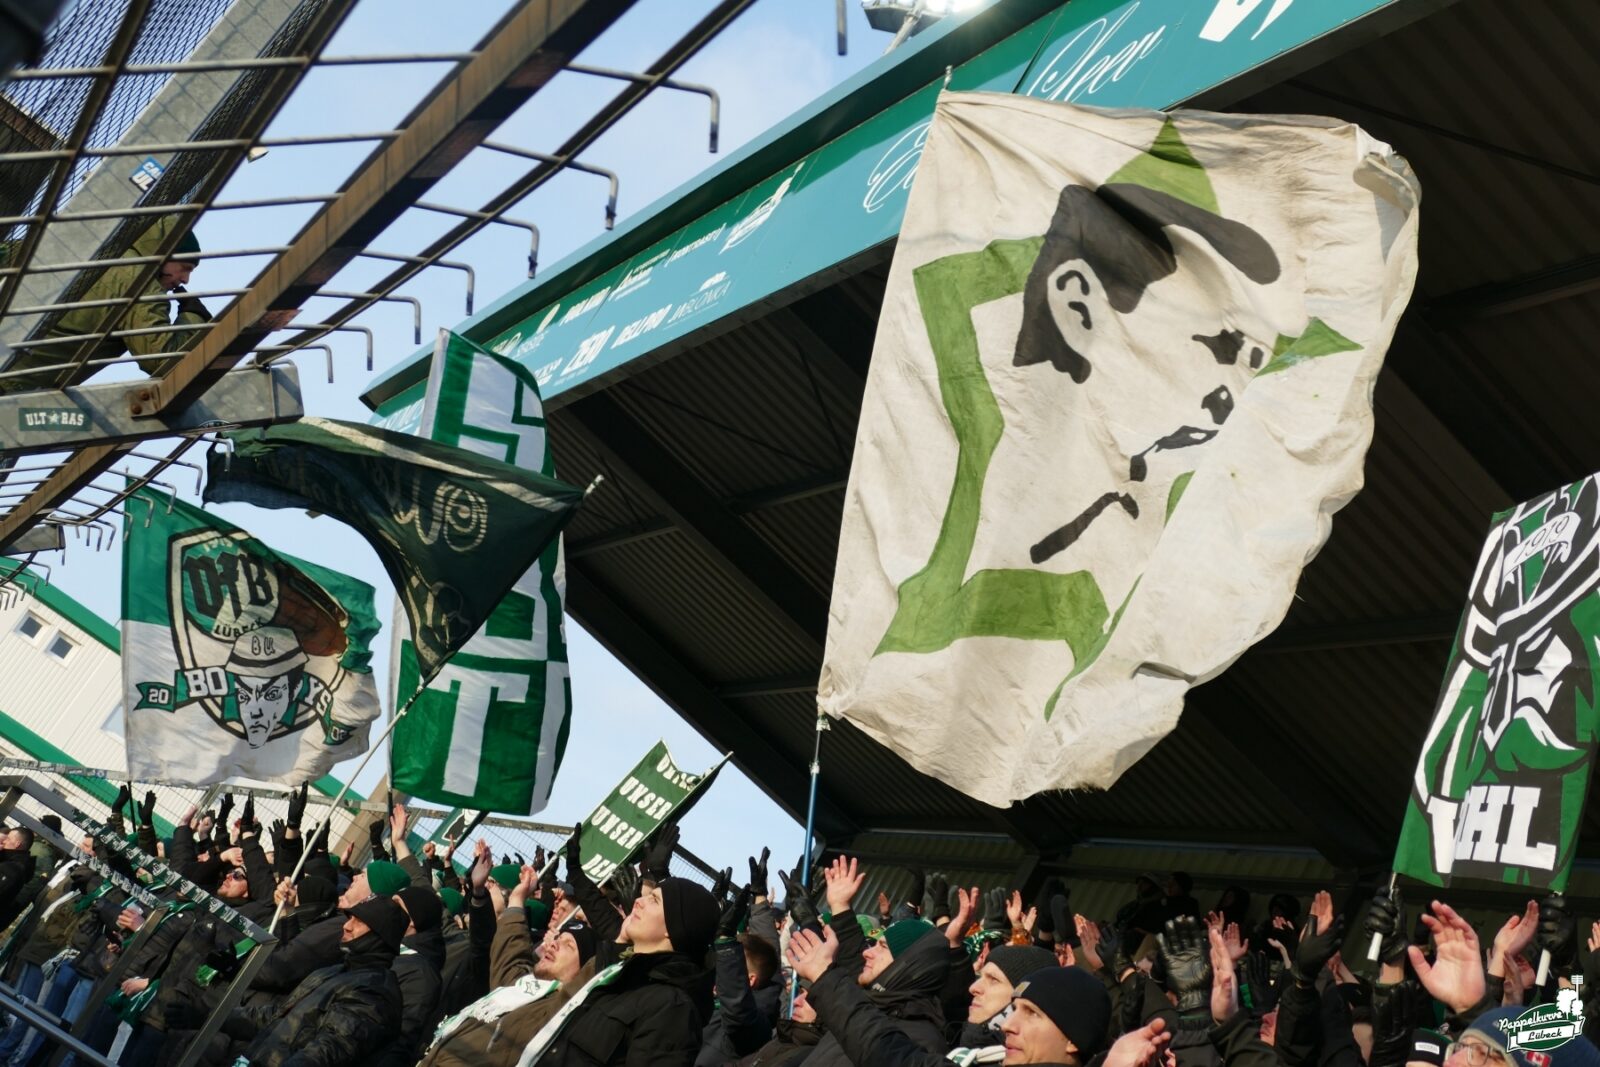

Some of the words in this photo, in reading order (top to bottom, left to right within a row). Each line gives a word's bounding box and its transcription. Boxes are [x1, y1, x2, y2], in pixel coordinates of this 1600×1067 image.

[1515, 515, 1570, 564] 1919
[148, 688, 169, 705] 20
[619, 776, 673, 820] UNSER
